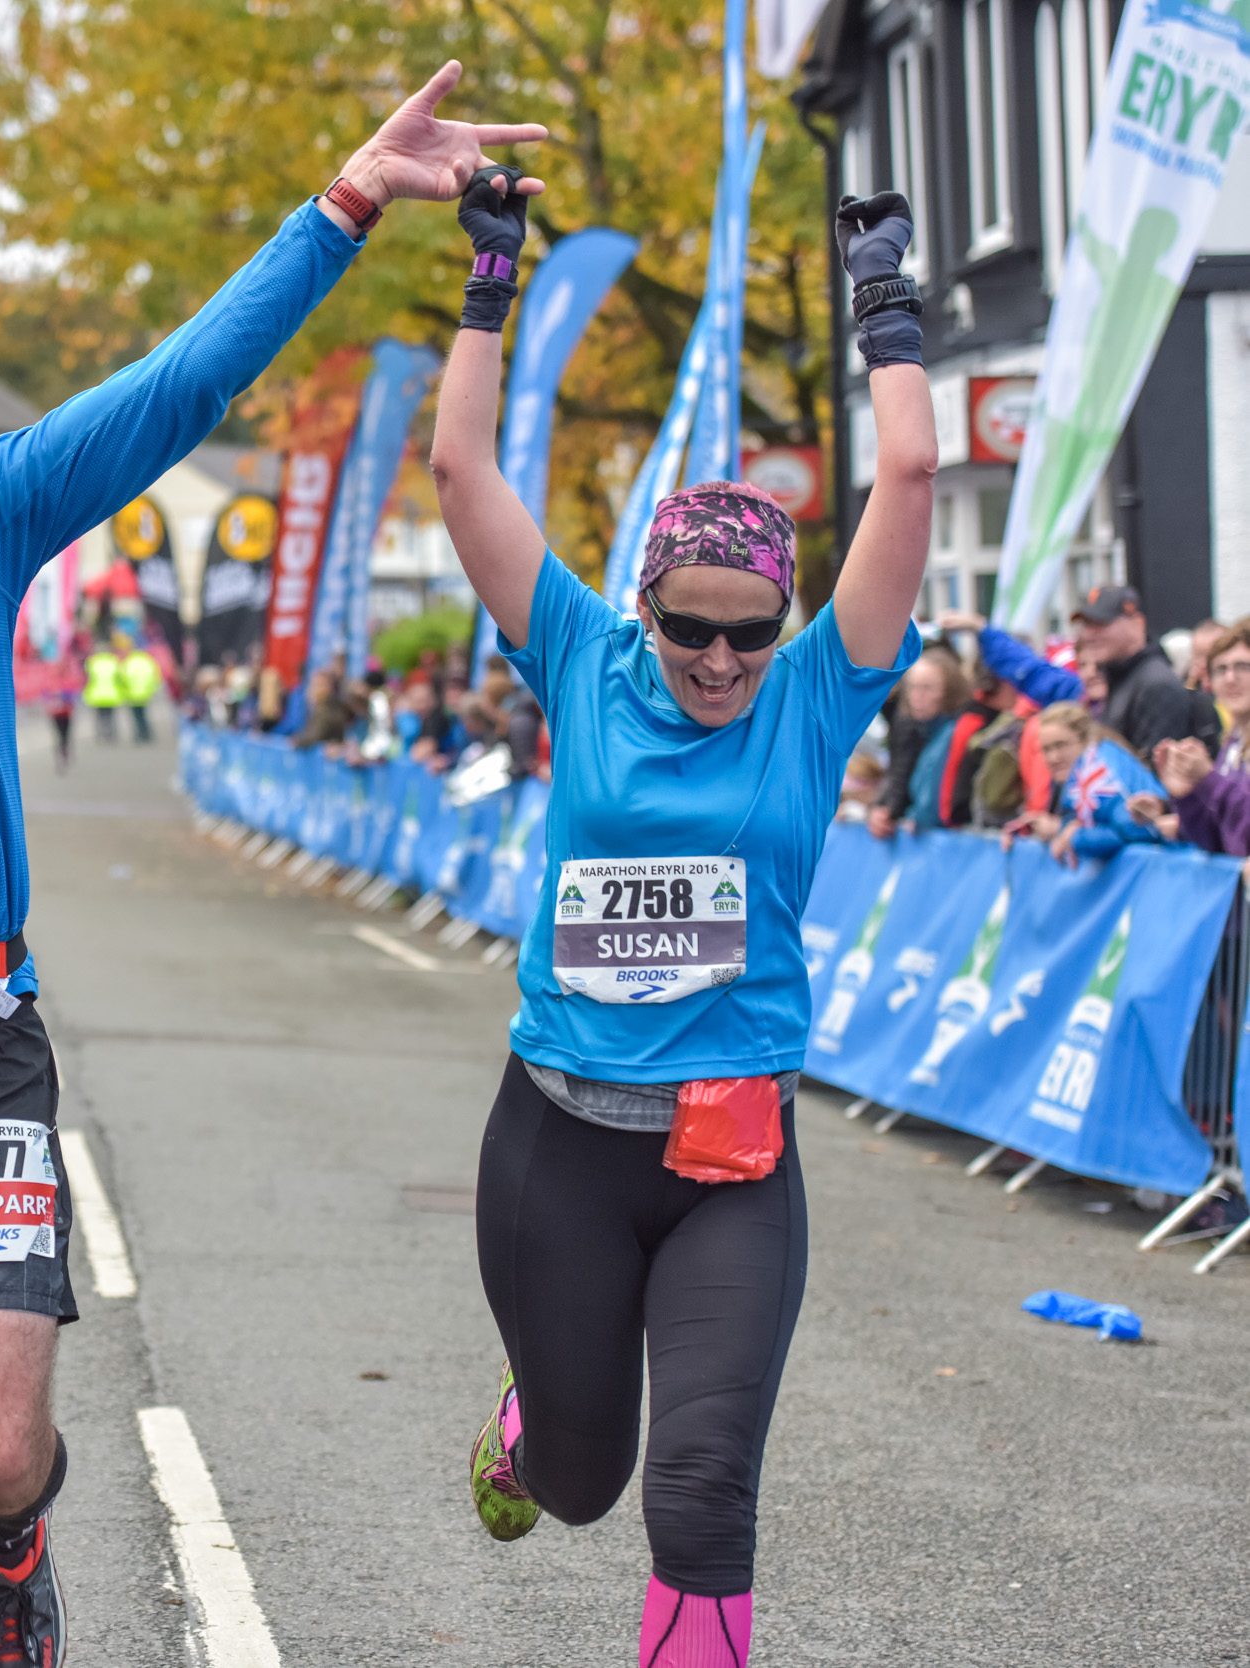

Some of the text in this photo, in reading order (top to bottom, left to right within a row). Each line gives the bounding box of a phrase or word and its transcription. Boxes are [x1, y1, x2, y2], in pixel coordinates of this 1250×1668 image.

[579, 863, 718, 877] MARATHON ERYRI 2016
[601, 878, 694, 920] 2758
[561, 903, 583, 915] ERYRI
[714, 901, 740, 911] ERYRI
[597, 932, 699, 959] SUSAN
[616, 969, 679, 982] BROOKS
[27, 1127, 43, 1138] 201
[45, 1166, 55, 1176] ERY
